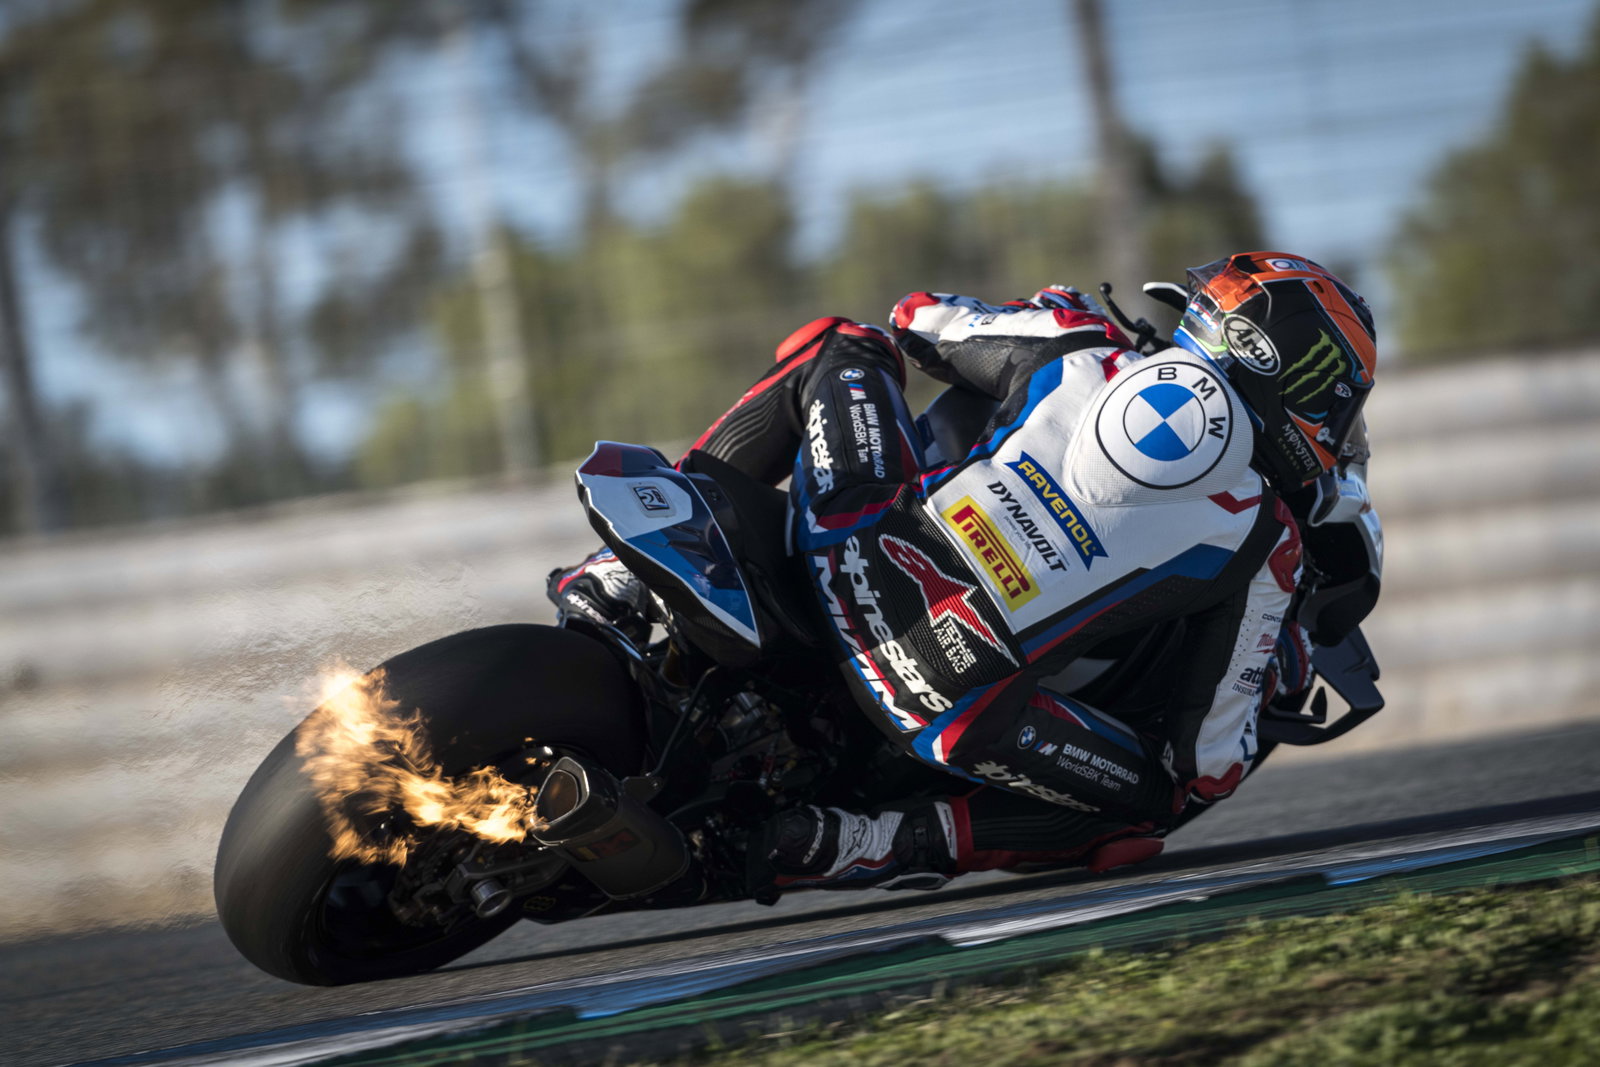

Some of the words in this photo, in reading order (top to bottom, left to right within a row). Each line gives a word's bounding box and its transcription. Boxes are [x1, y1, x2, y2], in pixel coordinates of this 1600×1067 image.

[1226, 318, 1276, 367] Arai
[863, 403, 880, 426] BMW
[1157, 366, 1227, 440] BMW
[1282, 422, 1316, 471] MONSTER
[986, 480, 1068, 572] DYNAVOLT
[1017, 460, 1094, 557] RAVENOL
[951, 504, 1031, 600] PIRELLI
[840, 535, 953, 713] alpinestars
[1056, 756, 1100, 782] WorldSBK
[1100, 774, 1122, 792] Team
[1062, 743, 1091, 763] BMW
[1091, 754, 1140, 785] MOTORRAD
